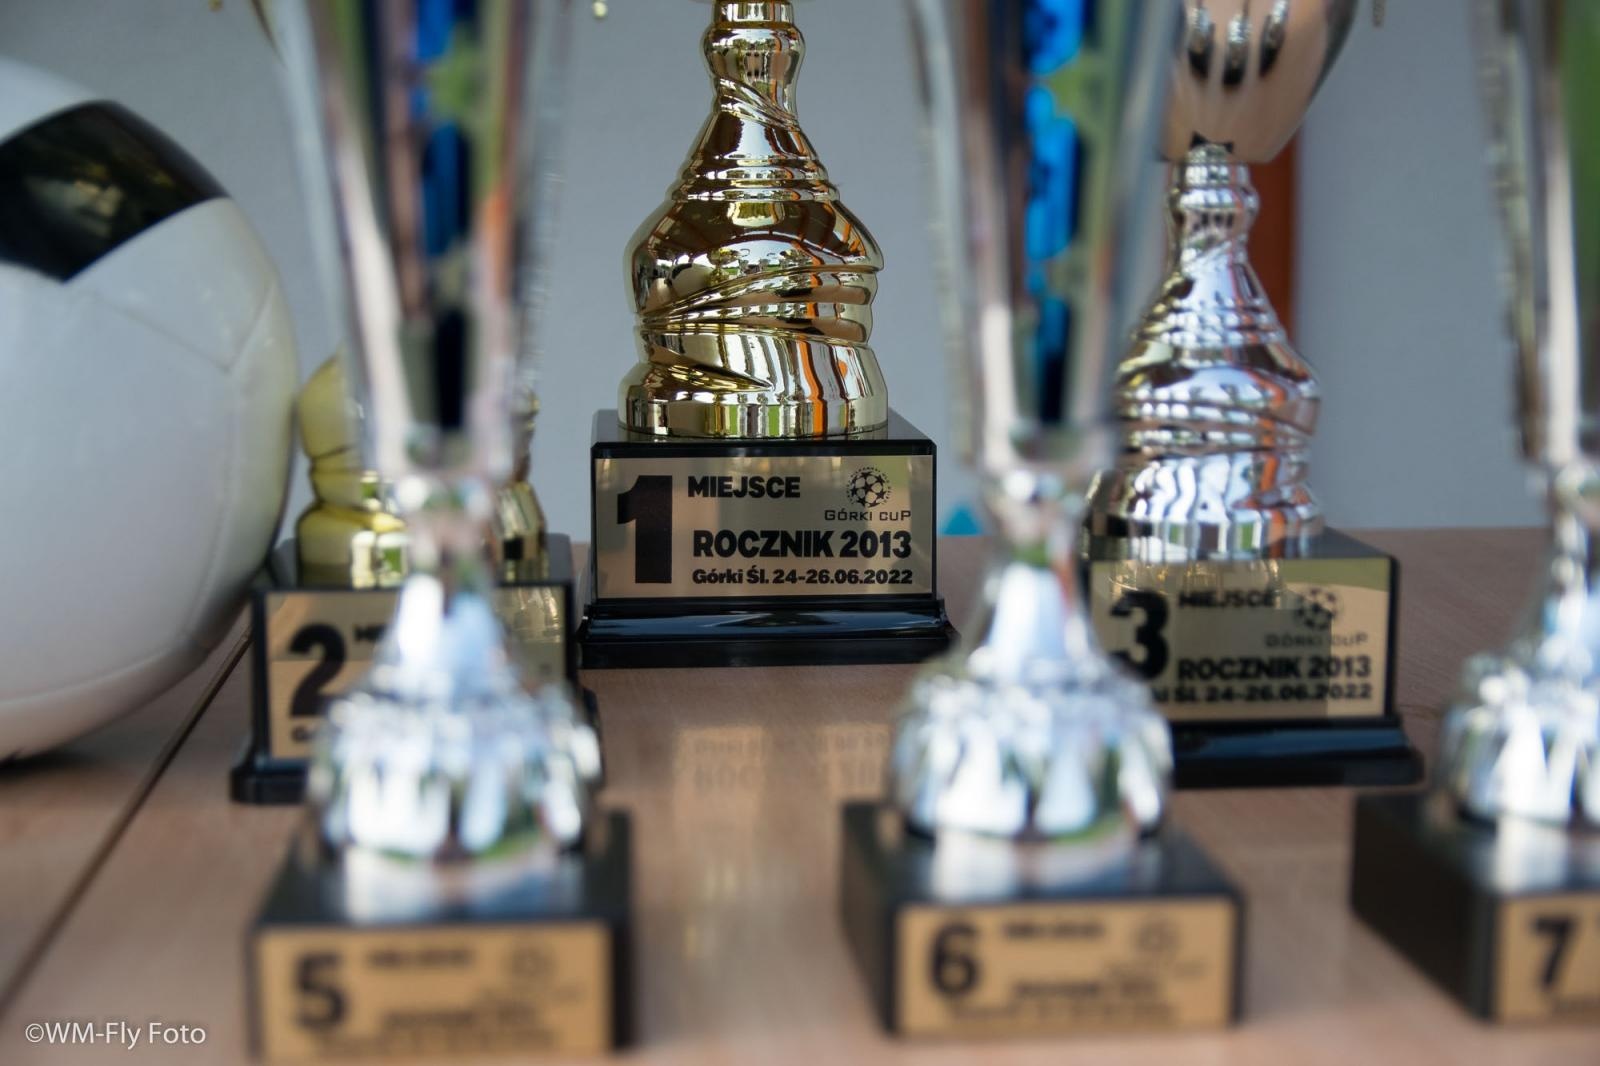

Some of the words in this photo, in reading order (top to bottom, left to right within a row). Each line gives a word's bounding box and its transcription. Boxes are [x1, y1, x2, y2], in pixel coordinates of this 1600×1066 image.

[687, 475, 801, 499] MIEJSCE
[616, 474, 673, 584] 1
[824, 508, 873, 522] GÓRKI
[692, 529, 834, 558] ROCZNIK
[838, 529, 912, 558] 2013
[692, 568, 744, 585] Górki
[745, 565, 770, 585] Śl.
[772, 568, 914, 585] 24-26.06.2022
[1176, 590, 1276, 608] MIEJSCE
[1109, 589, 1170, 682] 3
[288, 623, 347, 719] 2
[1177, 656, 1301, 681] ROCZNIK
[1308, 654, 1373, 680] 2013
[927, 921, 982, 1000] 6
[1532, 915, 1575, 991] 7
[294, 951, 346, 1029] 5
